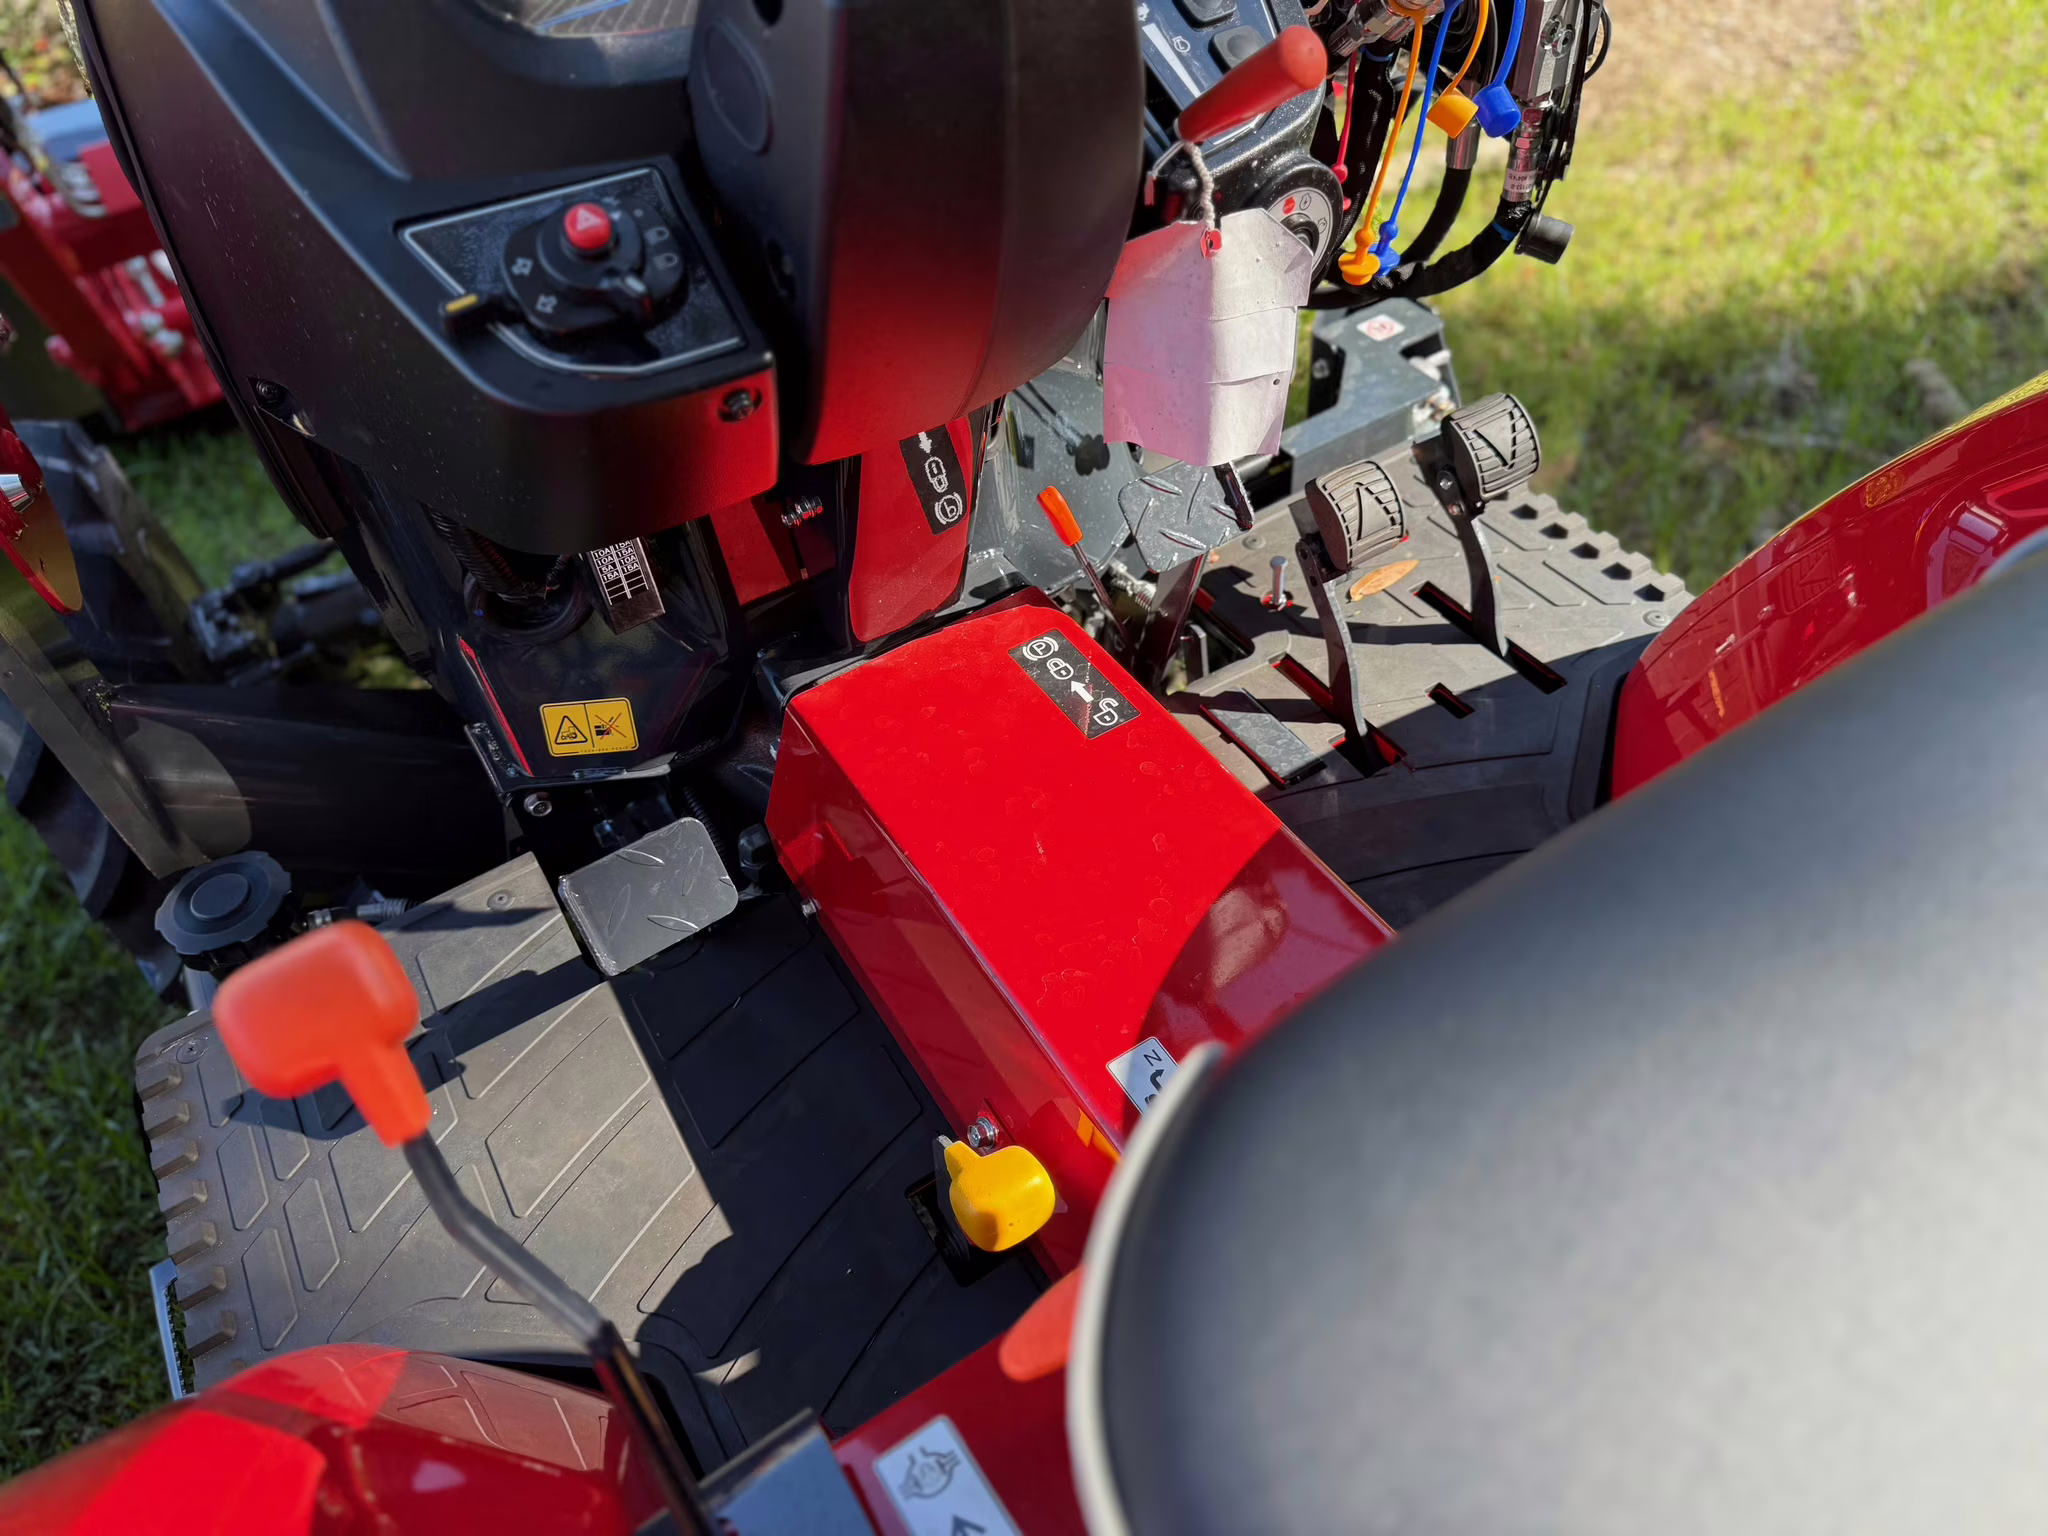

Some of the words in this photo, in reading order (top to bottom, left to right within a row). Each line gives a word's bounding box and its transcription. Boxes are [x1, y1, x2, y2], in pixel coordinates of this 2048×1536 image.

[615, 540, 631, 550] 15A
[594, 547, 611, 558] 10A
[617, 547, 634, 557] 15A
[597, 555, 614, 566] 10A
[620, 555, 637, 565] 10A
[601, 564, 614, 573] 5A
[623, 563, 639, 573] 15A
[603, 571, 619, 581] 15A
[1032, 643, 1046, 656] P
[1143, 1049, 1162, 1067] N
